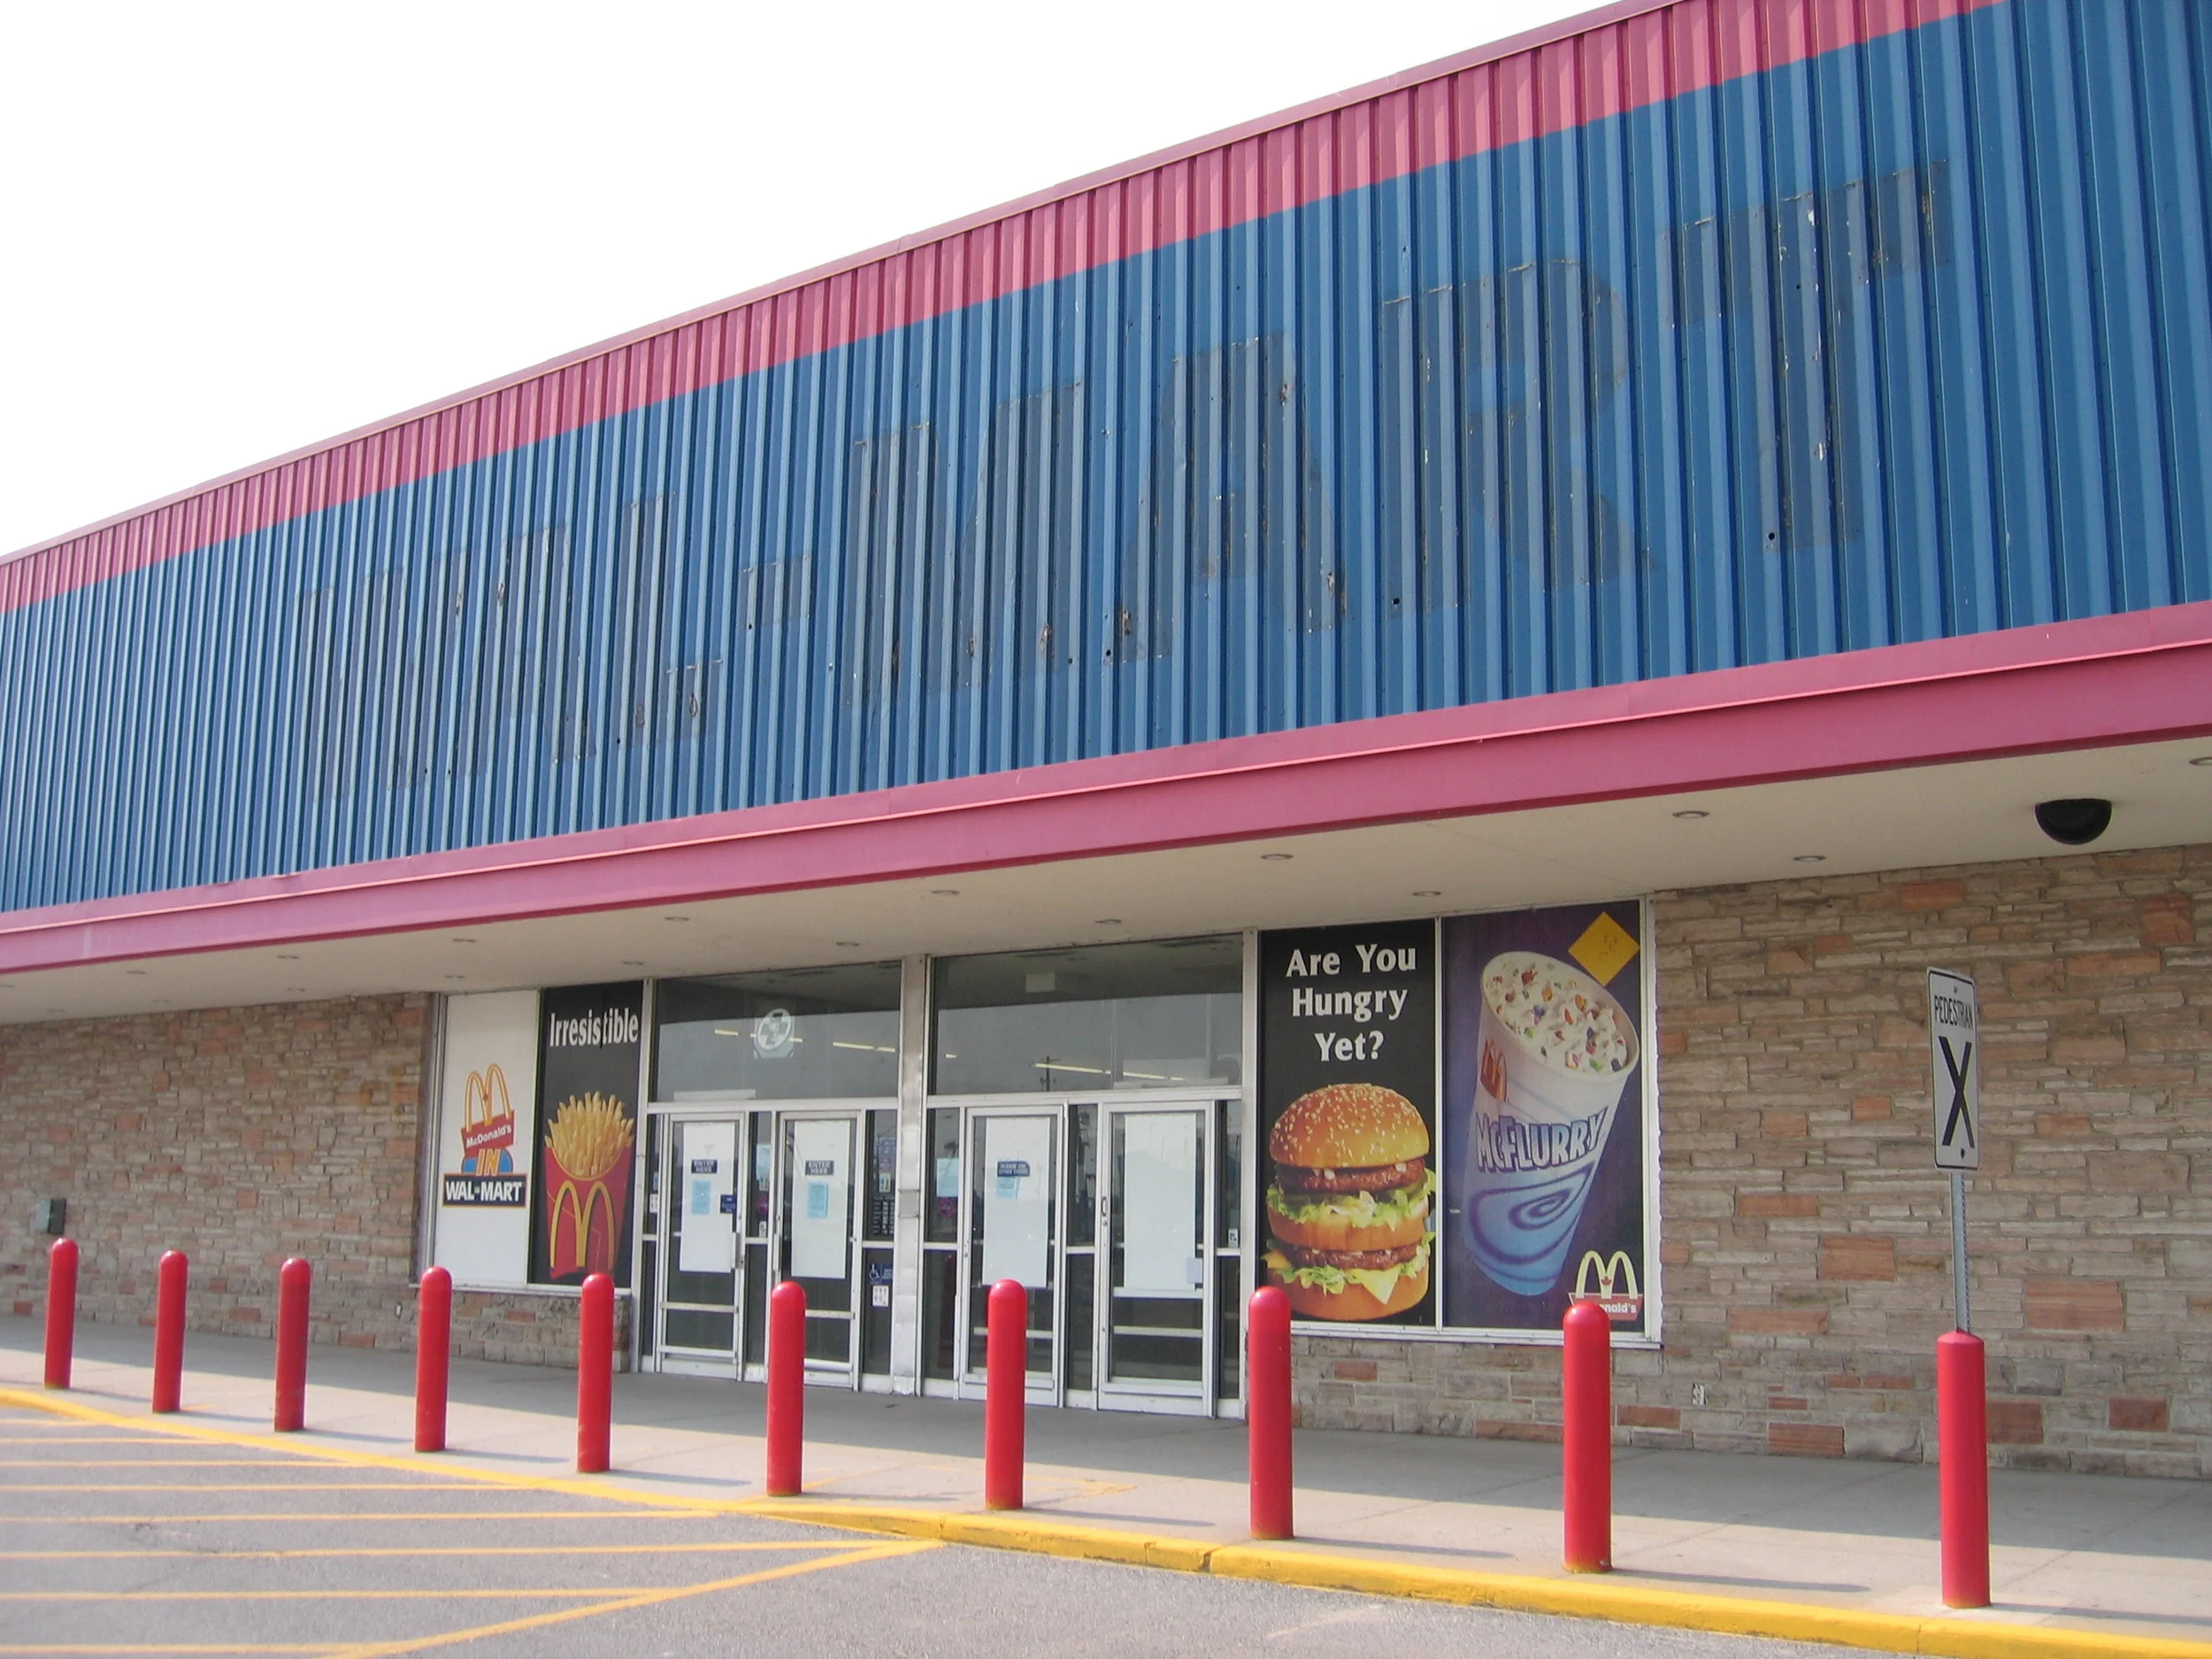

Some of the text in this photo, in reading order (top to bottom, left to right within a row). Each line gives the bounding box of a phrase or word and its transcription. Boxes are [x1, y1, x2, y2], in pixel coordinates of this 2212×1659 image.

[1286, 943, 1416, 977] Are You
[1292, 987, 1408, 1022] Hungry
[549, 1007, 639, 1047] Irresistible
[1314, 1030, 1384, 1062] Yet?
[465, 1124, 512, 1148] McDonald's
[475, 1148, 502, 1177] IN
[445, 1180, 523, 1202] WAL-MART
[1604, 1302, 1637, 1314] nald's
